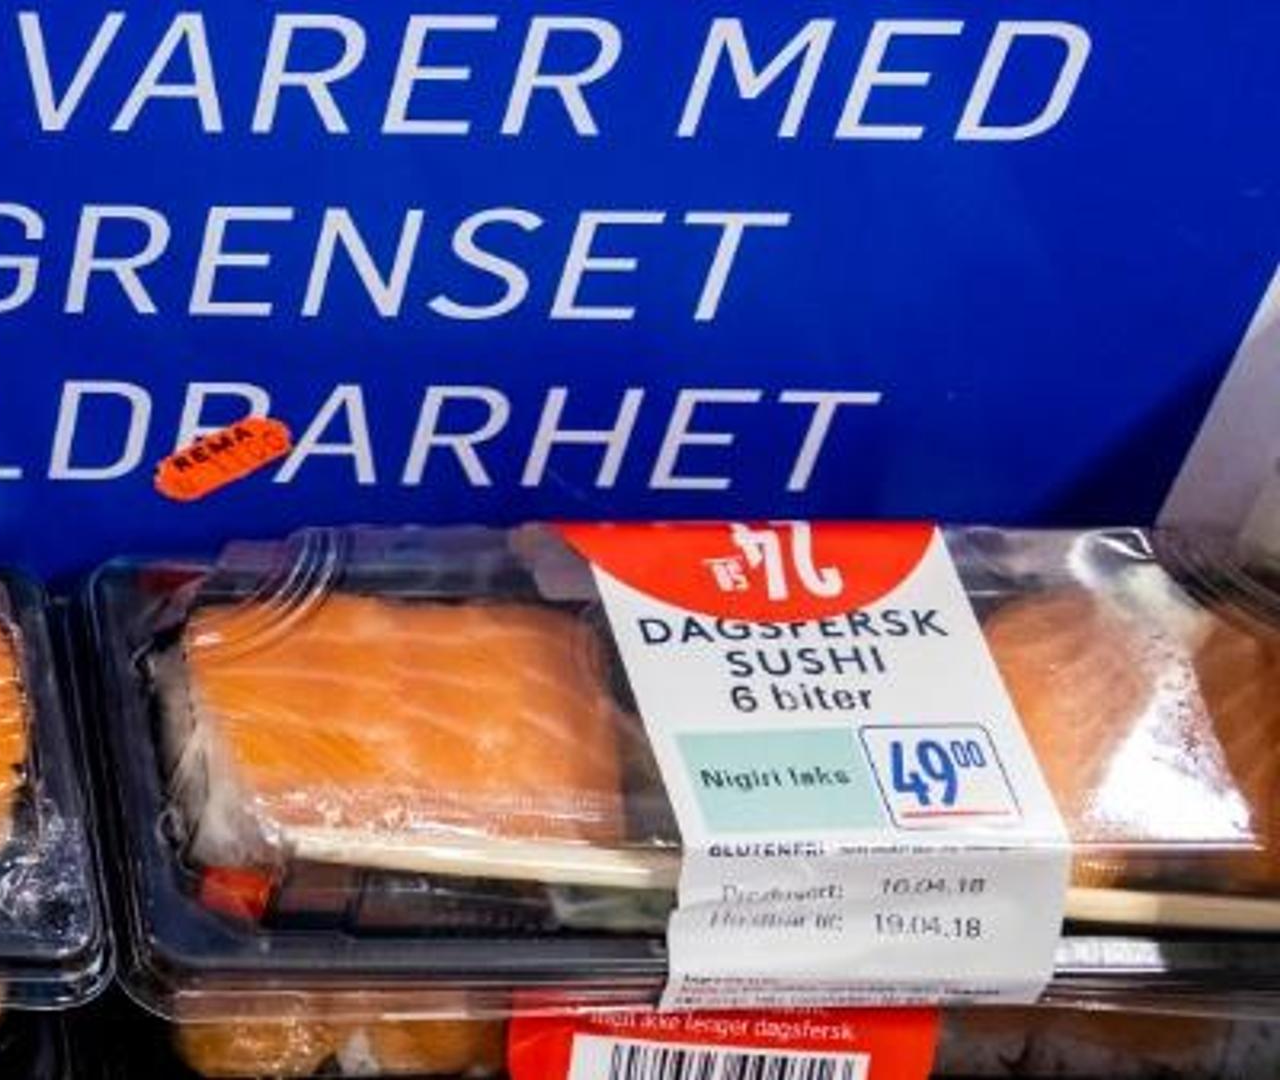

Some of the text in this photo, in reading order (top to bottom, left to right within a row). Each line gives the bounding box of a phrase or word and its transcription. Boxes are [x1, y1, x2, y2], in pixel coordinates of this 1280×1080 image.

[18, 12, 621, 134] VARER
[677, 18, 1091, 141] MED
[639, 608, 950, 645] DAGSFERSK
[724, 644, 887, 678] SUSHI
[729, 682, 873, 713] 6 biter
[699, 765, 852, 791] Nigiri laks
[873, 911, 983, 939] 19.04.18
[682, 1011, 748, 1038] lenger
